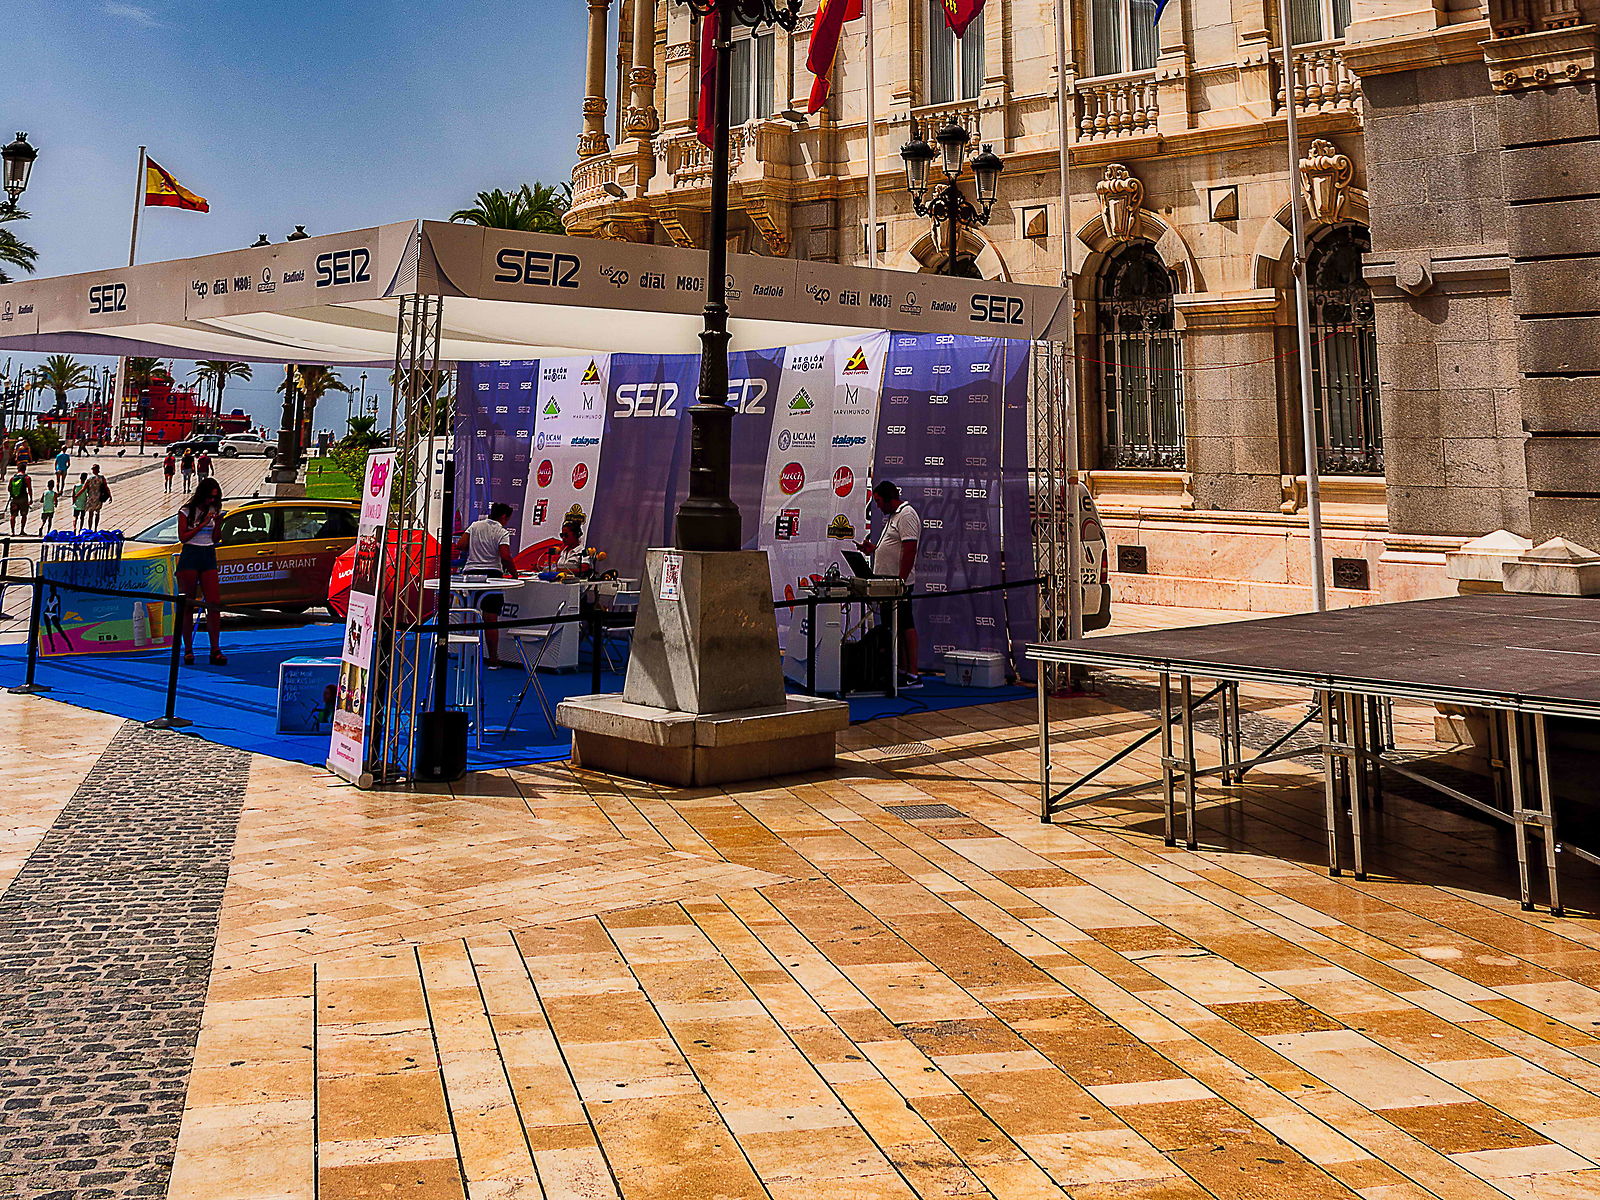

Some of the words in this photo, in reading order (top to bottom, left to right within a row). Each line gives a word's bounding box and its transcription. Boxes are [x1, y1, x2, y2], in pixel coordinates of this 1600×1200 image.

[316, 248, 370, 288] SER
[494, 248, 580, 288] SER
[213, 278, 228, 295] dial
[283, 270, 304, 283] Radiolé
[640, 272, 666, 290] dial
[677, 275, 699, 291] M80
[753, 284, 784, 297] Radiolé
[89, 283, 126, 313] SER
[839, 290, 861, 305] dial
[869, 293, 888, 308] M80
[931, 301, 957, 313] Radiolé
[970, 294, 1023, 324] SER
[935, 335, 955, 345] SER
[793, 355, 825, 363] REGIÓN
[791, 361, 823, 371] MURCIA
[894, 366, 913, 376] SER
[970, 363, 991, 373] SER
[613, 382, 680, 418] SER
[695, 378, 769, 415] ER
[929, 395, 949, 404] SER
[886, 425, 906, 435] SER
[966, 425, 988, 435] SER
[570, 435, 600, 446] atalayas
[792, 432, 816, 440] UCAM
[924, 456, 945, 466] SER
[964, 488, 987, 499] SER
[923, 519, 943, 529] SER
[967, 553, 989, 563] SER
[217, 564, 244, 575] UEVO
[246, 562, 273, 572] GOLF
[276, 558, 317, 570] VARIANT
[501, 603, 520, 619] ER
